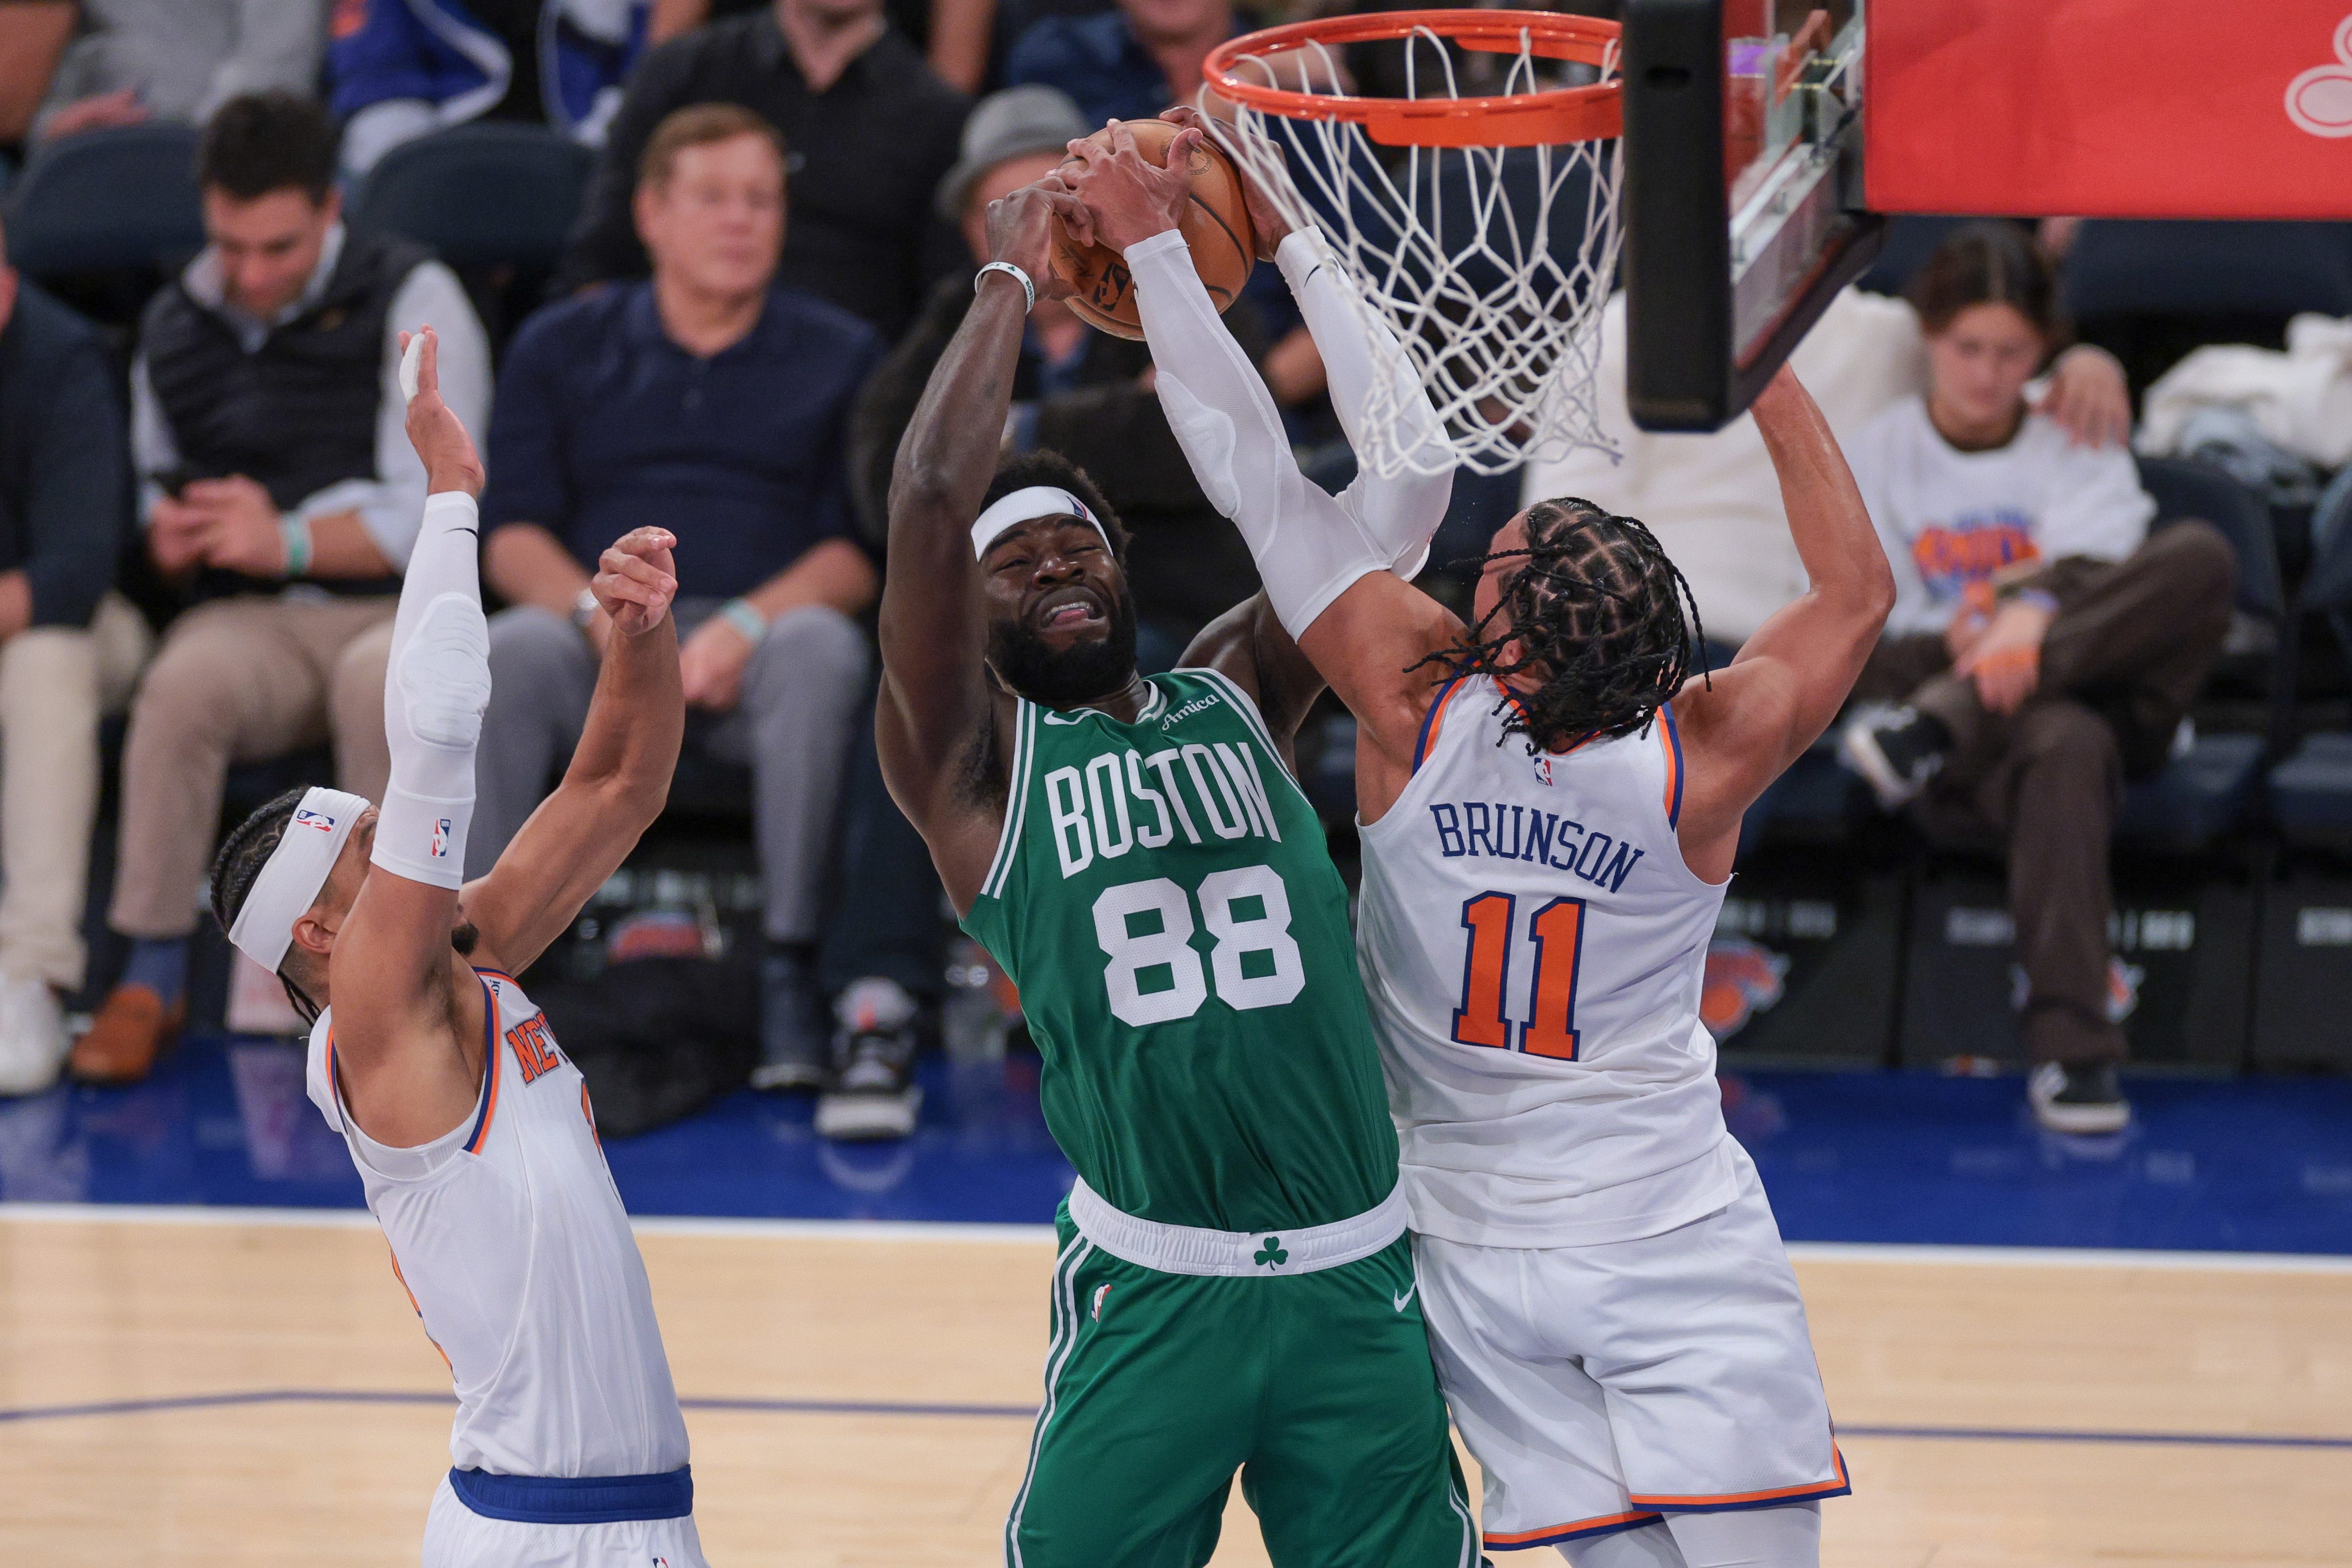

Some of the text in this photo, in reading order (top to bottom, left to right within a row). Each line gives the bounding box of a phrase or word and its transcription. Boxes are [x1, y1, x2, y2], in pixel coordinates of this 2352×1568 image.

[1161, 693, 1220, 731] Amica
[1044, 742, 1281, 879] BOSTON
[1429, 802, 1644, 894] BRUNSON
[1092, 865, 1306, 1027] 88
[1451, 890, 1586, 1062] 11
